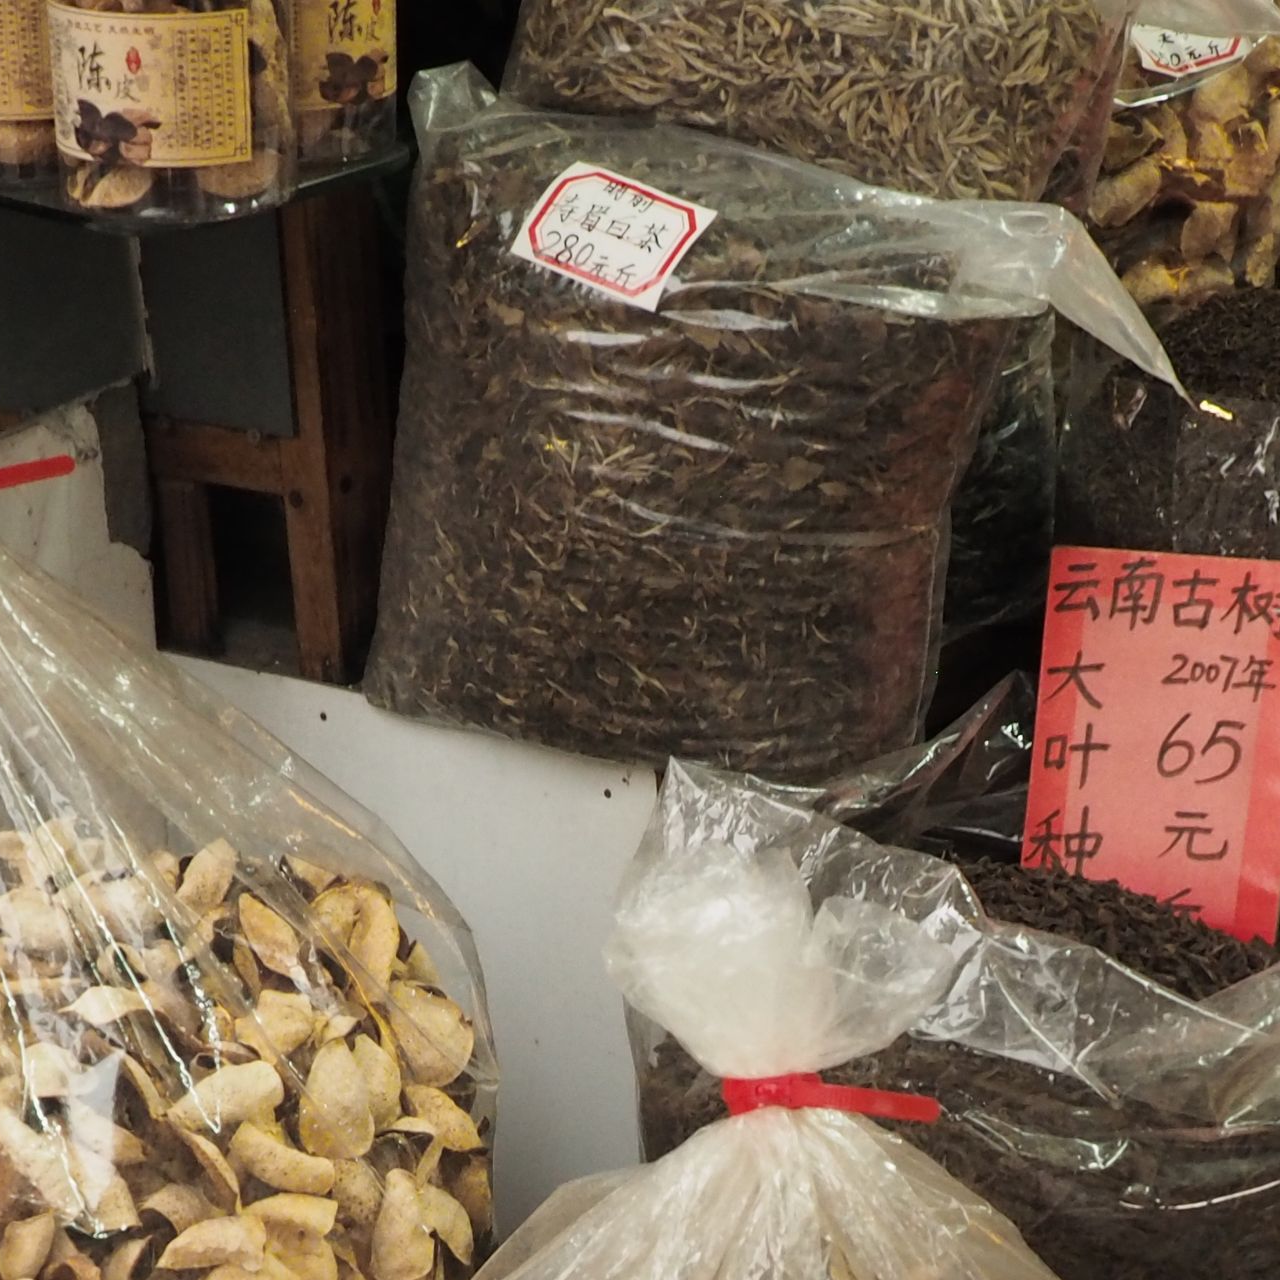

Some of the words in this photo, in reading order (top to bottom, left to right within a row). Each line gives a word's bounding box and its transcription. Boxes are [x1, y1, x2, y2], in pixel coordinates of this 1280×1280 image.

[76, 40, 141, 103] 陈皮
[1162, 653, 1277, 702] 2007年
[1156, 712, 1247, 786] 65
[1158, 811, 1229, 862] 元
